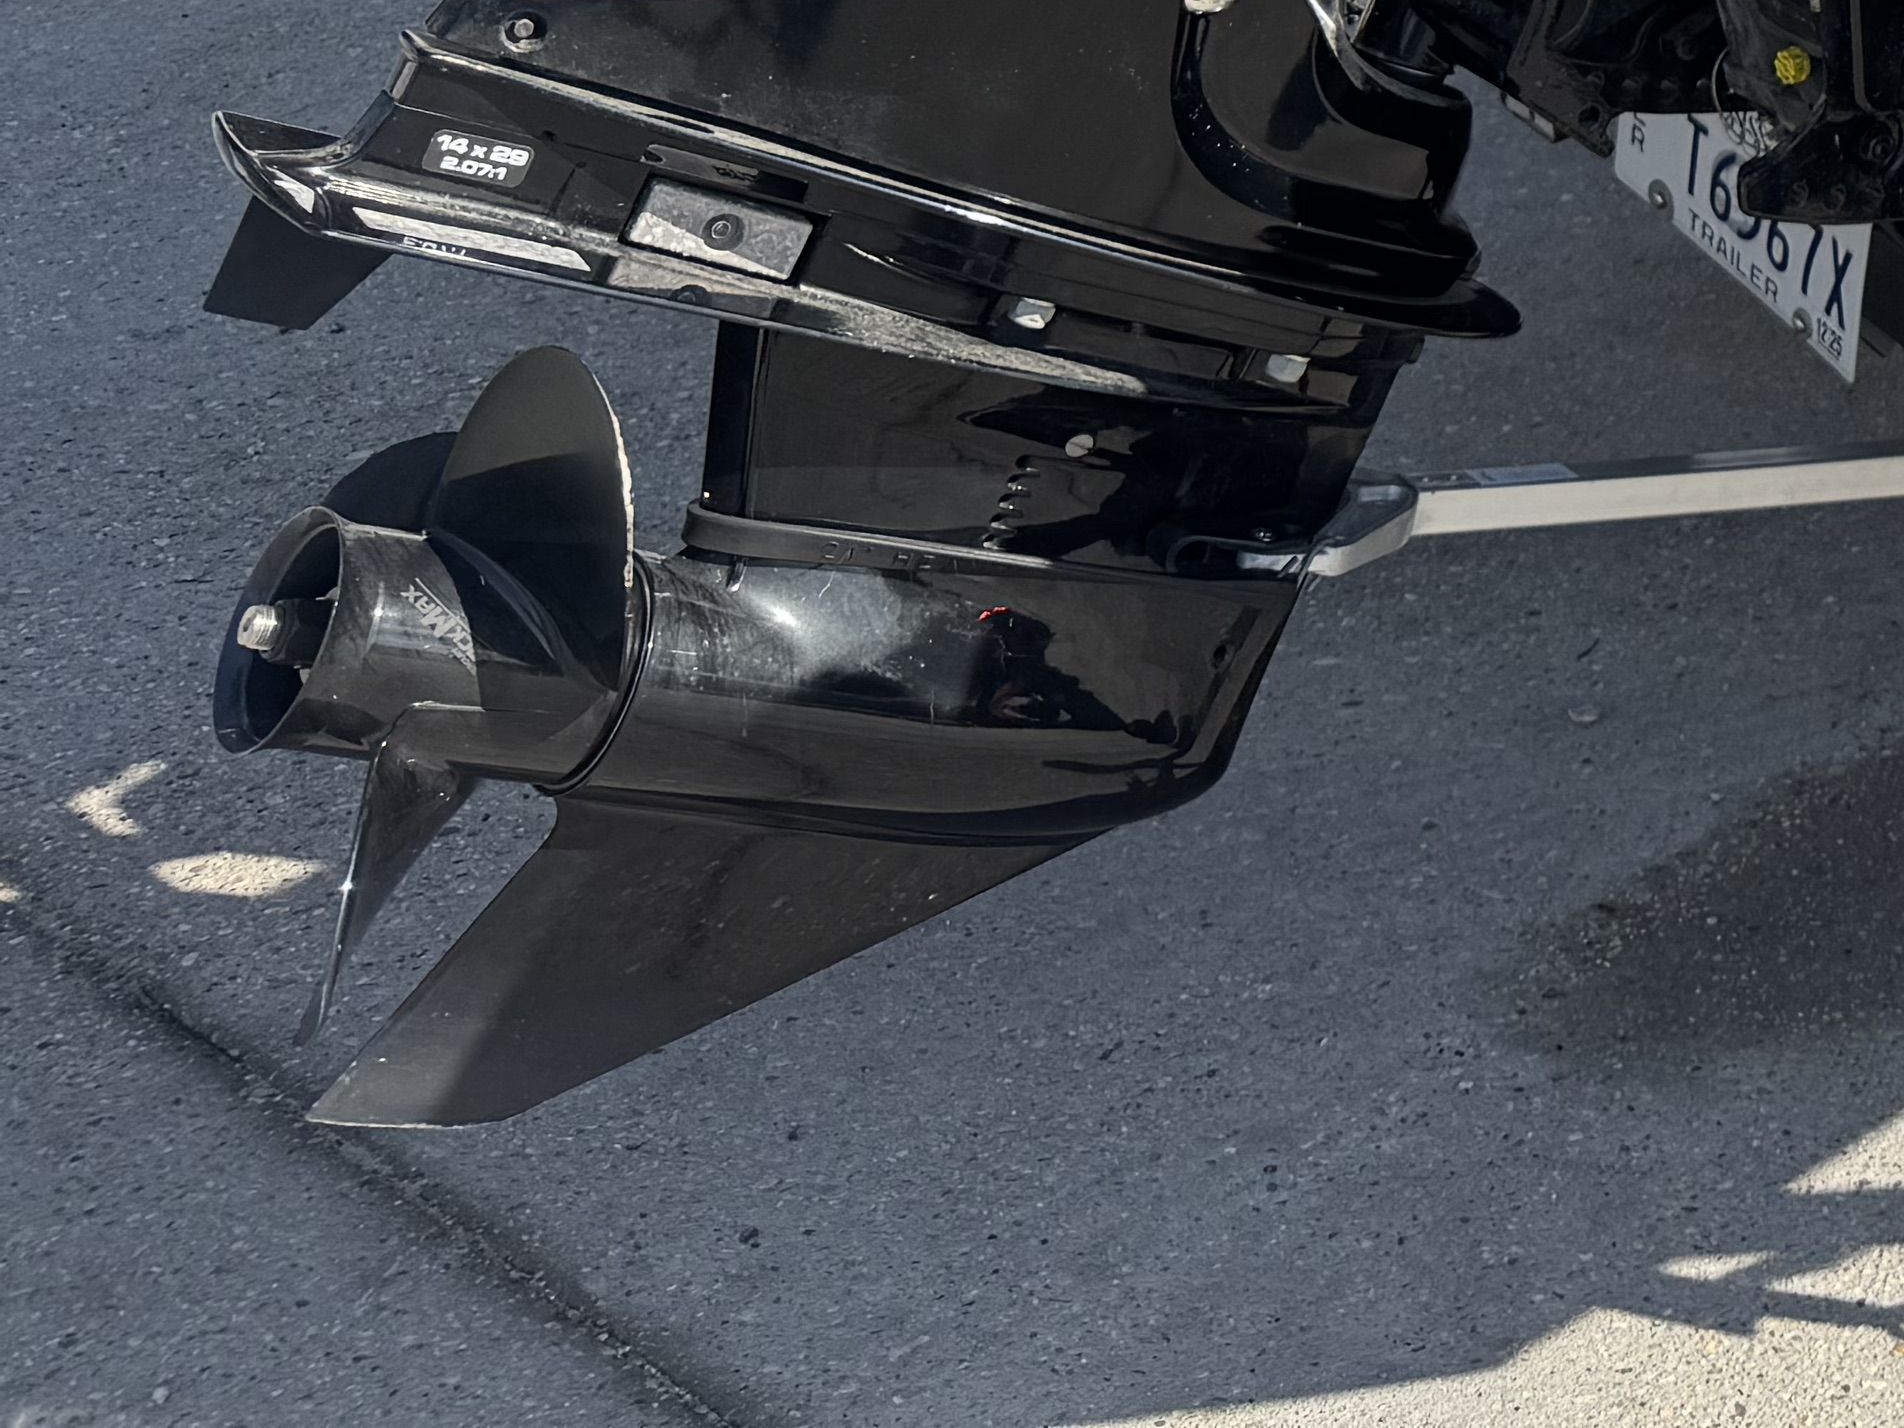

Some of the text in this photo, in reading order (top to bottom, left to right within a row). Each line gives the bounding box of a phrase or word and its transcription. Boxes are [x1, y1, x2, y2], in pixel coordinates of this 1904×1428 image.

[437, 134, 469, 155] 14
[470, 144, 488, 159] x
[1686, 112, 1854, 331] T667X
[1688, 207, 1779, 304] TRAILER
